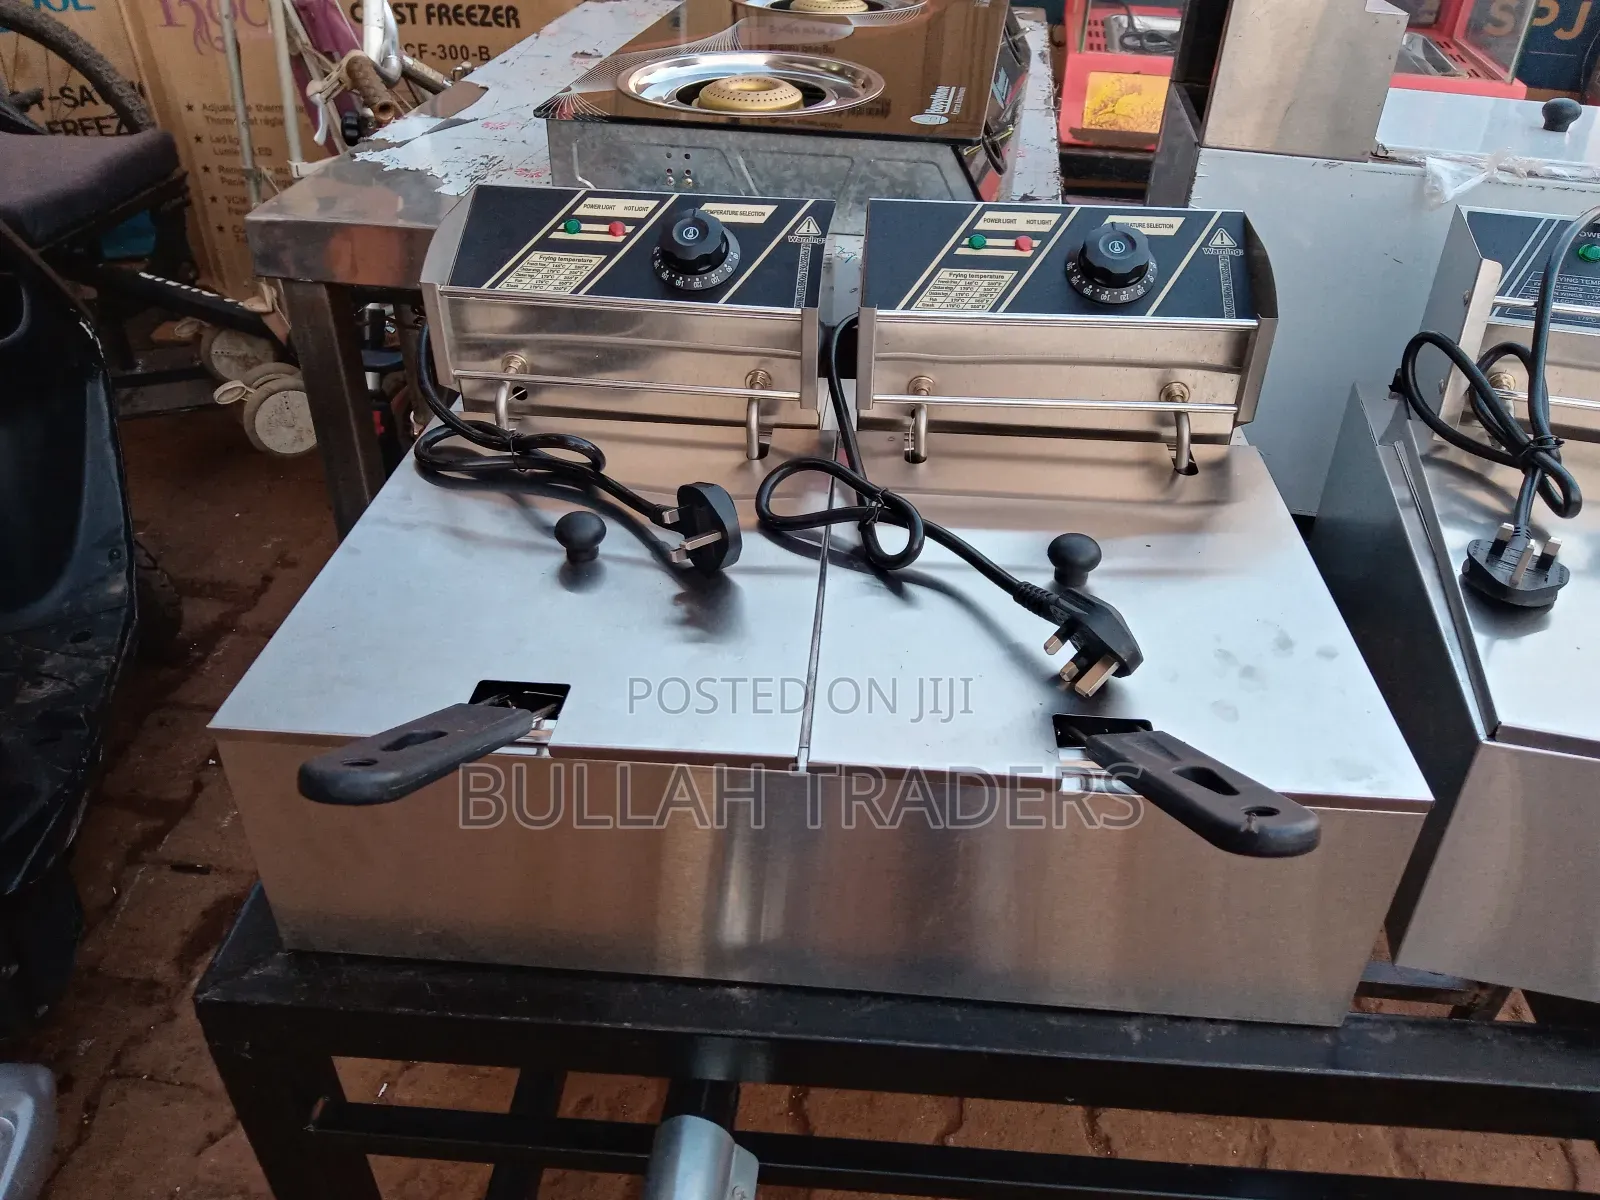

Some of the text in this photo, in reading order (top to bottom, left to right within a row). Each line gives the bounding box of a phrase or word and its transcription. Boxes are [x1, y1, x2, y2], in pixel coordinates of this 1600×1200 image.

[350, 3, 521, 29] CST FREEZER
[402, 43, 491, 61] CF-300-B
[705, 209, 738, 217] EMPERATURE
[558, 256, 593, 264] temperature
